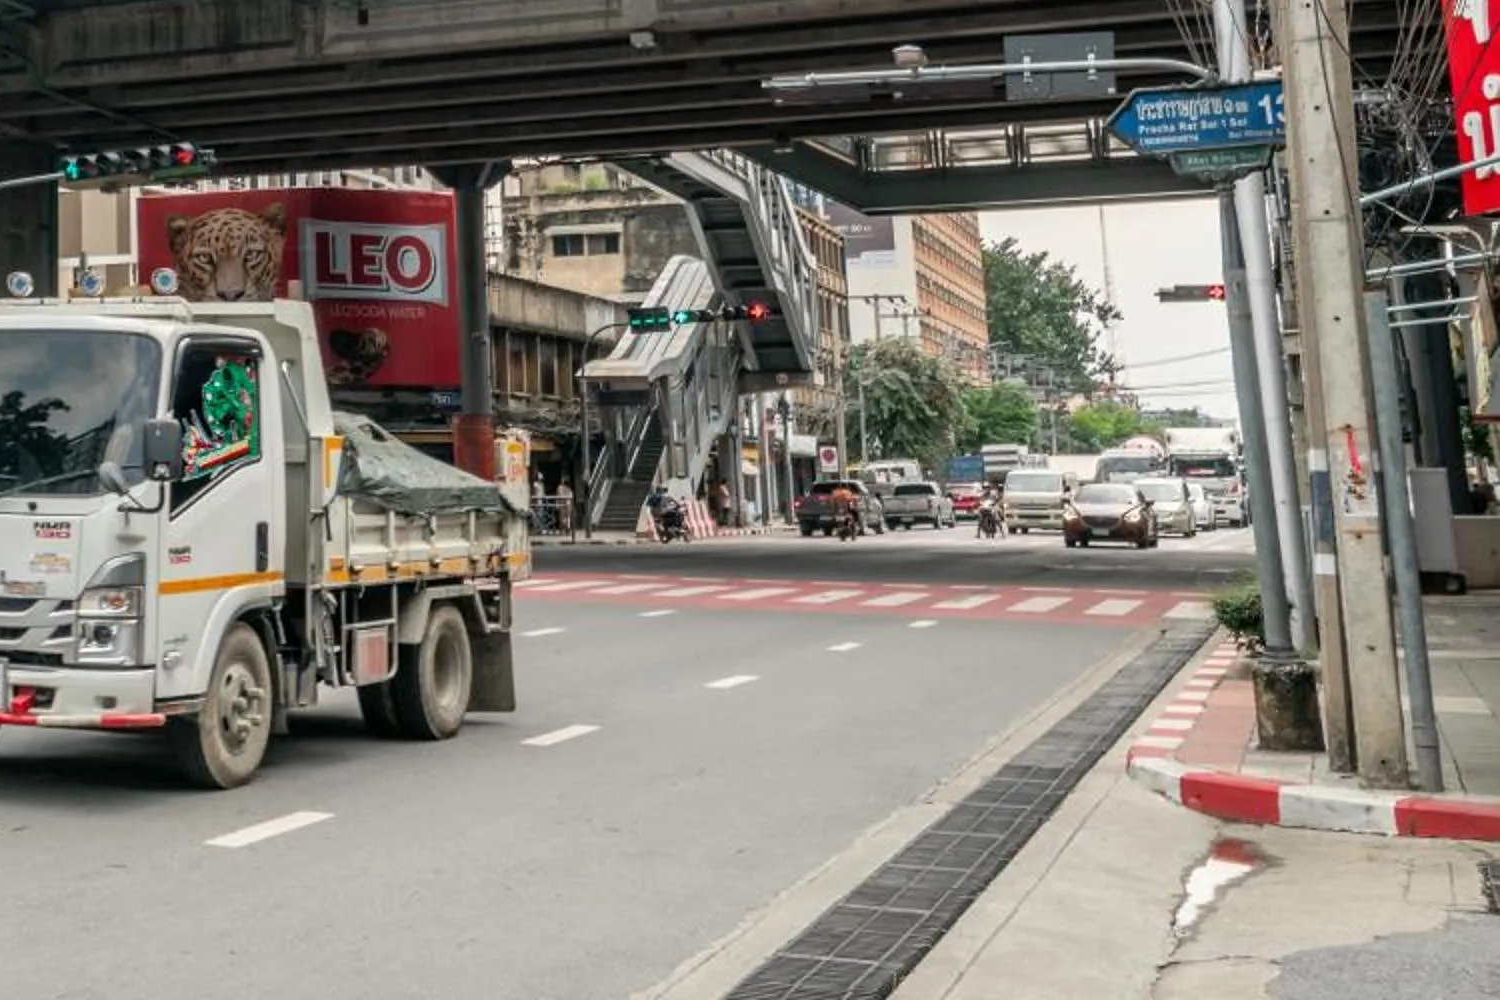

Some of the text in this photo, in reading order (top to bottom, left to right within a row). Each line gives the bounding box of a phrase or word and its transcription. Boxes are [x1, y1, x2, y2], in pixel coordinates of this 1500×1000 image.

[314, 231, 438, 293] LEO
[356, 304, 387, 318] SODA
[389, 305, 427, 320] WATER
